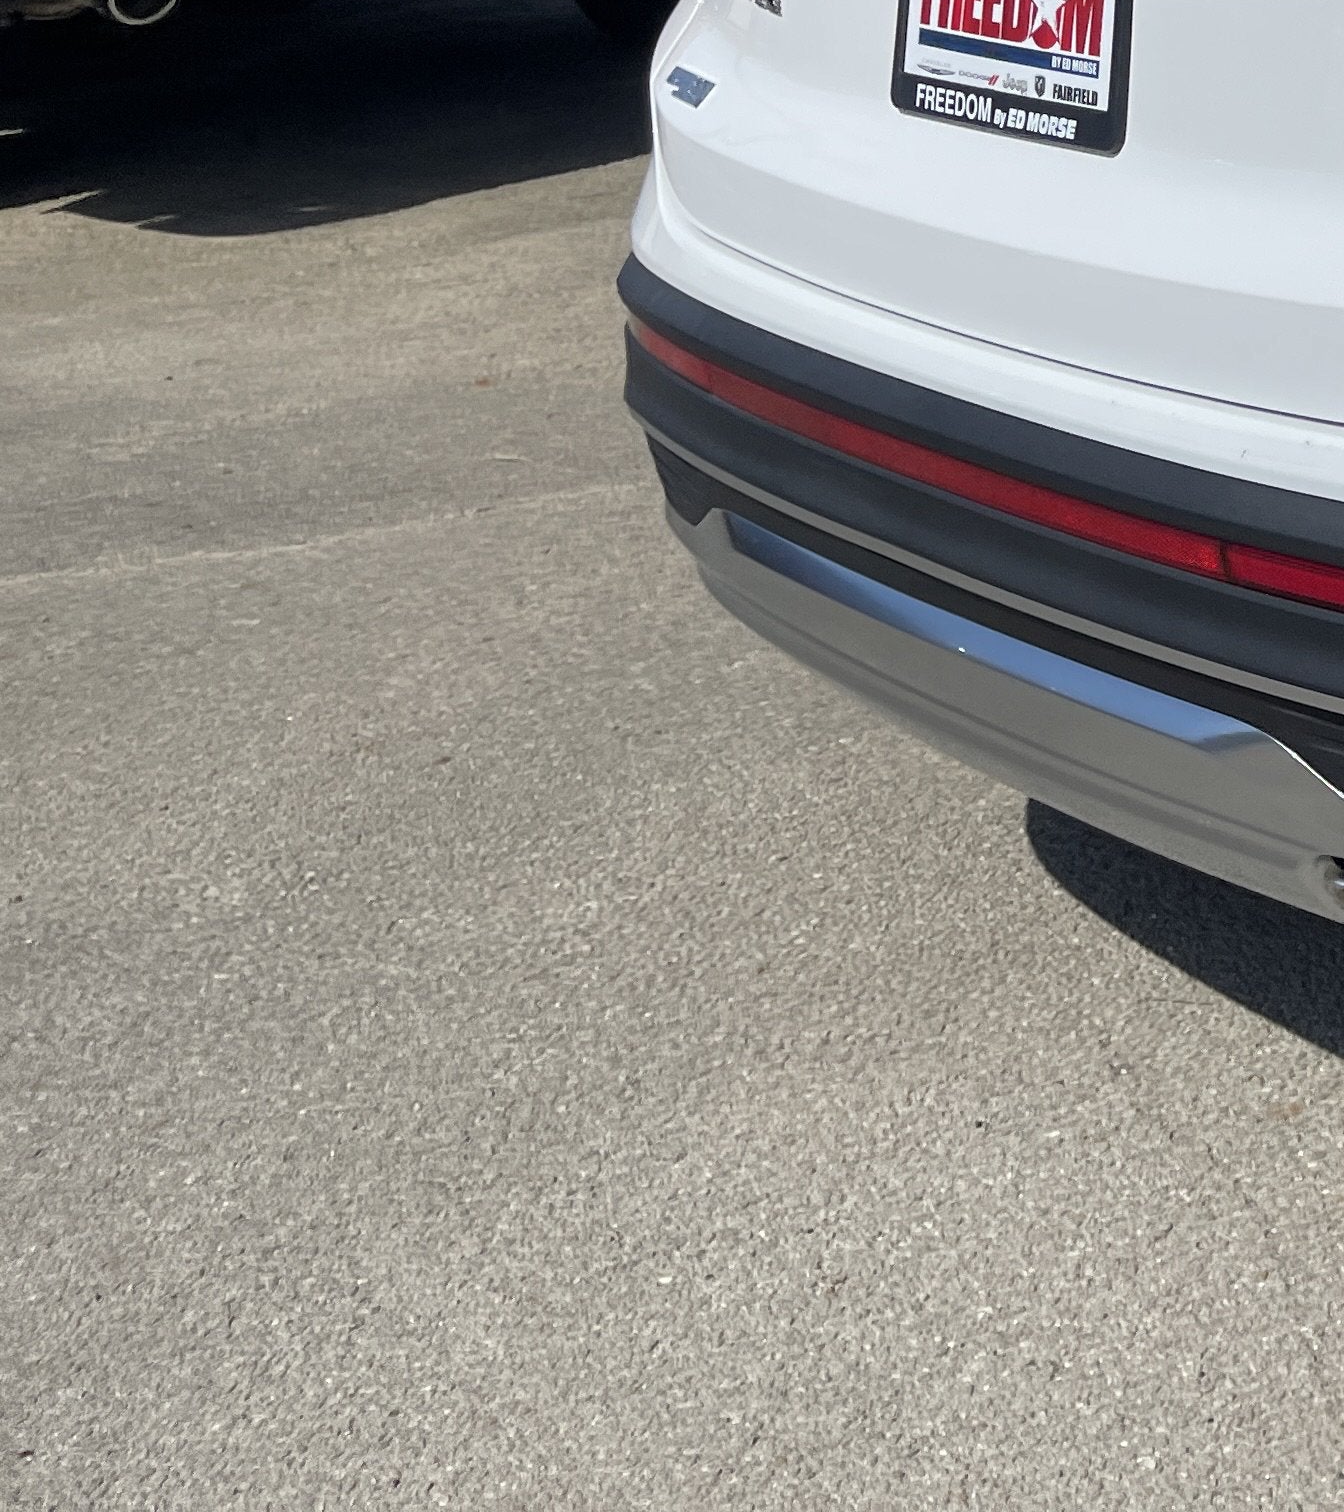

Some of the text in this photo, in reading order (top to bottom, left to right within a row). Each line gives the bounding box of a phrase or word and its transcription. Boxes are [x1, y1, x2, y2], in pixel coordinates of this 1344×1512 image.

[1051, 55, 1097, 75] BY ED MORSE
[1052, 83, 1098, 106] FAIRFIELD
[915, 83, 993, 123] FREEDOM
[1007, 107, 1026, 130] ED
[1026, 110, 1078, 140] MORSE
